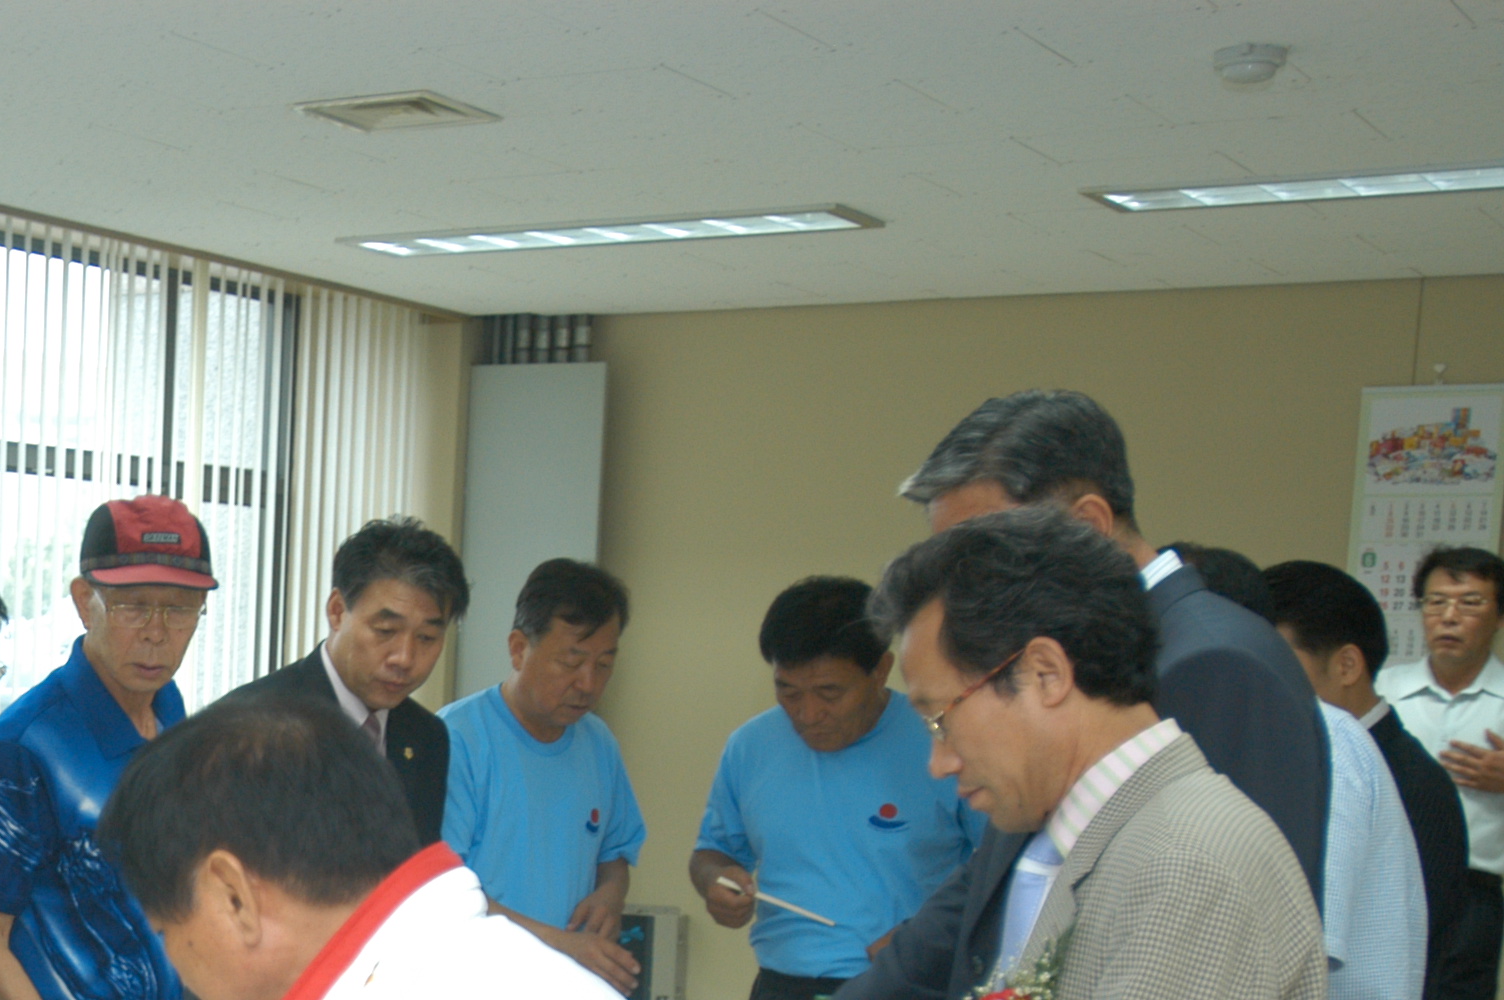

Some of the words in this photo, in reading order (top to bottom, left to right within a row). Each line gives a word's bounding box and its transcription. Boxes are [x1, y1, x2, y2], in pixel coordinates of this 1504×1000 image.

[1380, 574, 1390, 584] 12
[1396, 574, 1406, 584] 13
[1393, 587, 1405, 597] 20
[1393, 601, 1404, 611] 27
